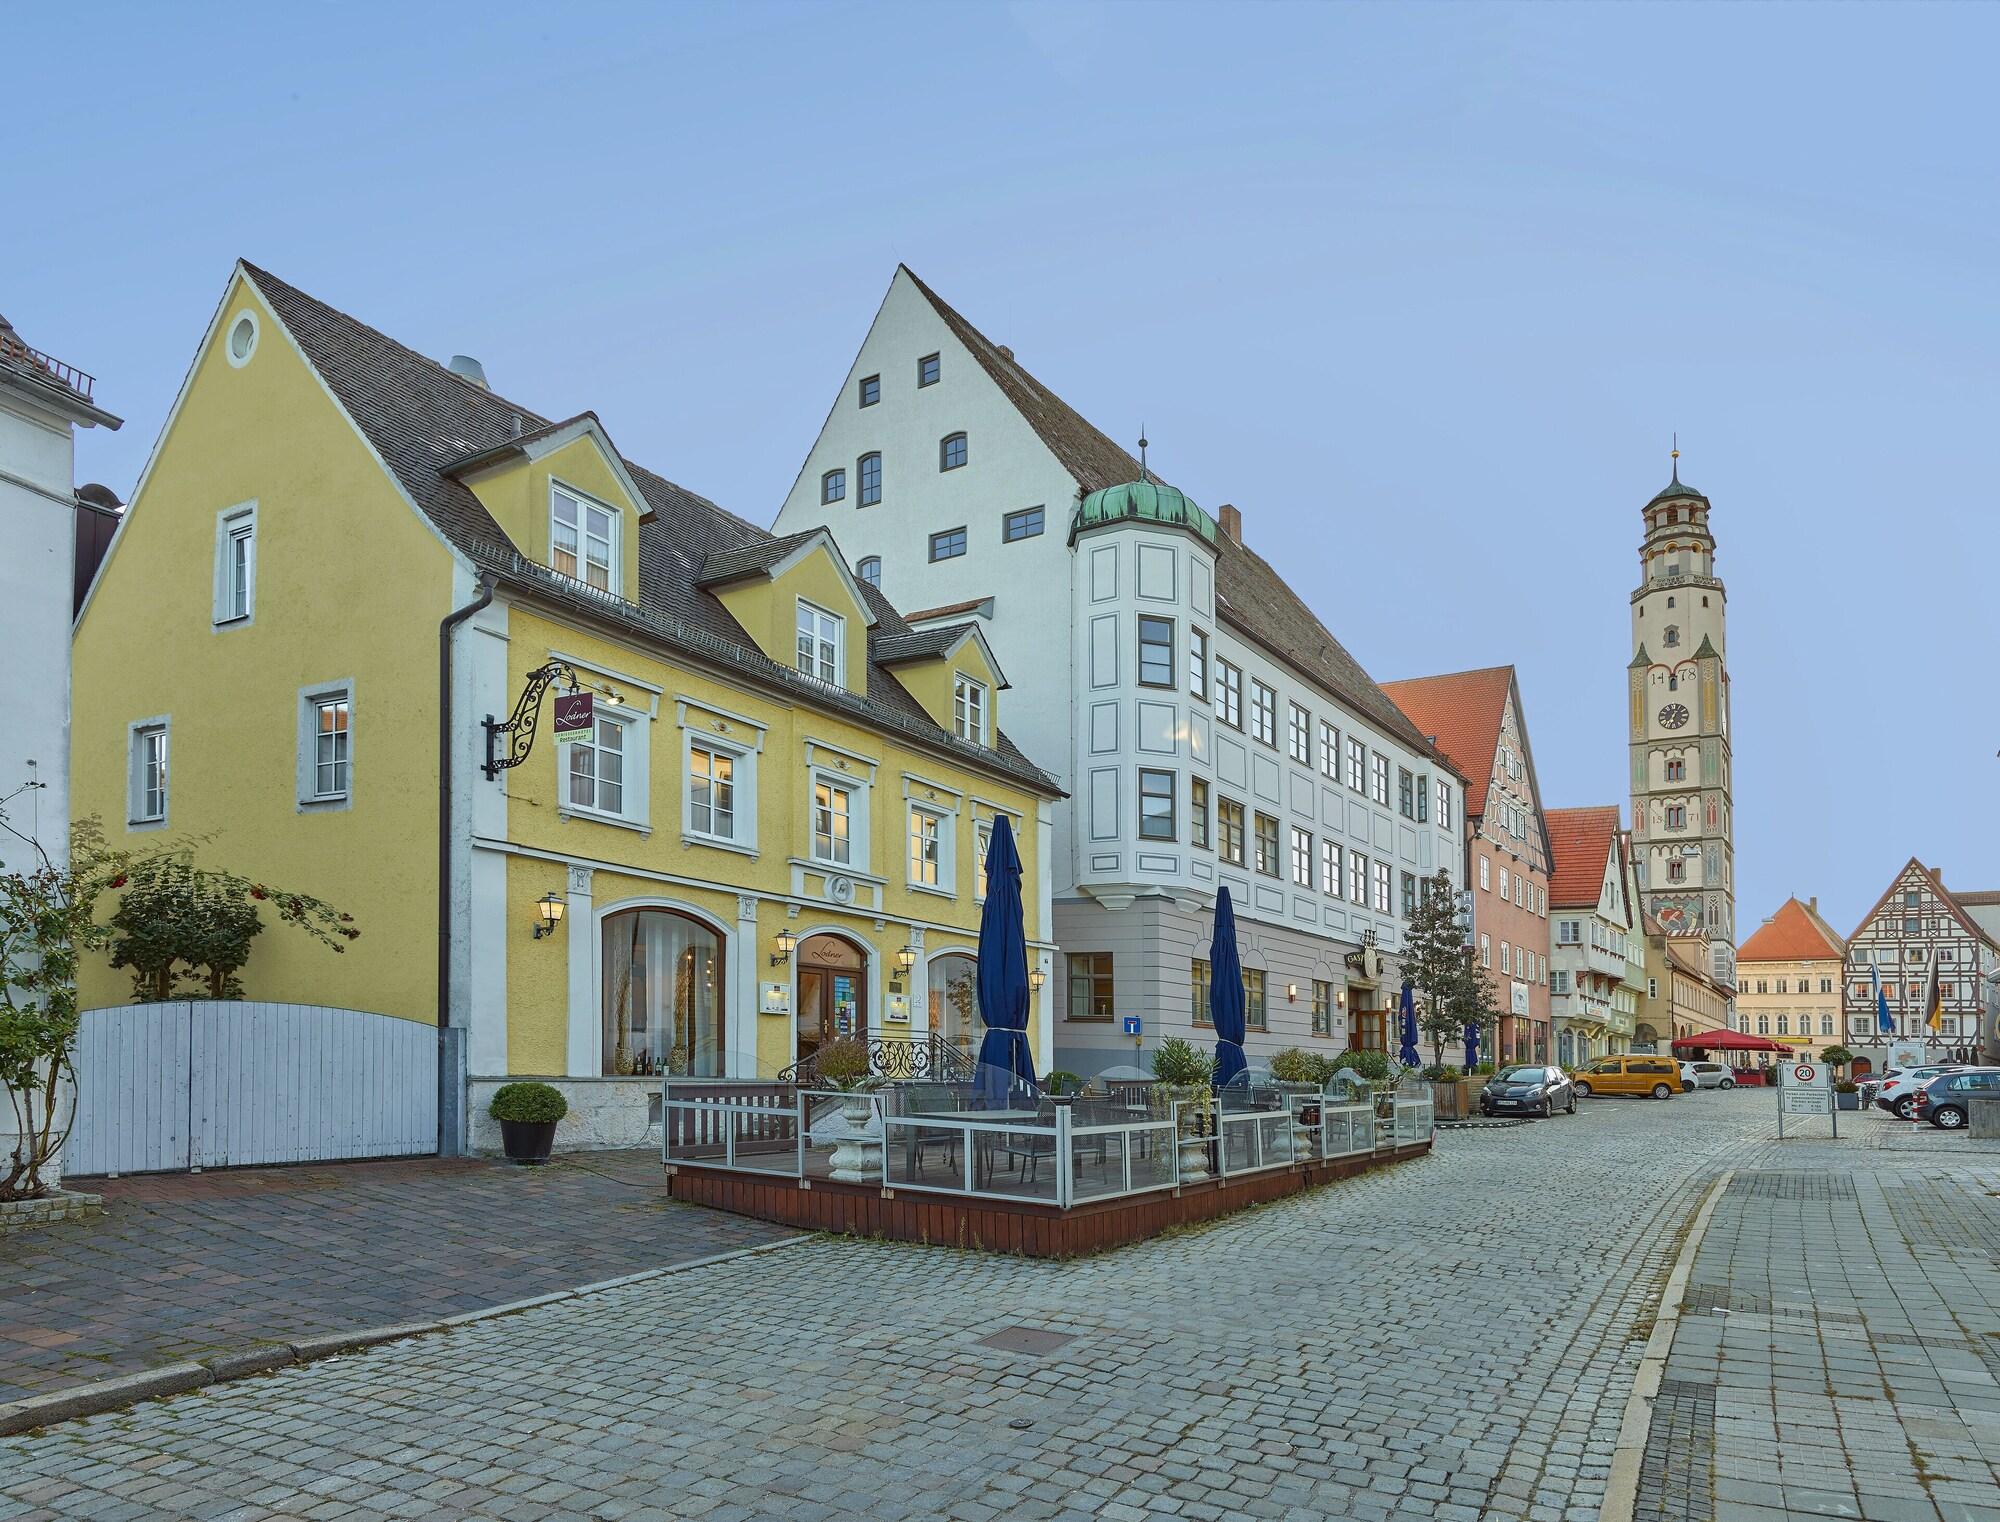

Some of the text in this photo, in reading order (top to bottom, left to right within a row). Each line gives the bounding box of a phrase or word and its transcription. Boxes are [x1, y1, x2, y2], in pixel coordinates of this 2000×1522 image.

[1678, 668, 1696, 681] 78
[556, 700, 591, 727] Lodner
[560, 734, 587, 743] Restaurant
[811, 940, 842, 964] Lodner
[1799, 1069, 1811, 1078] 20
